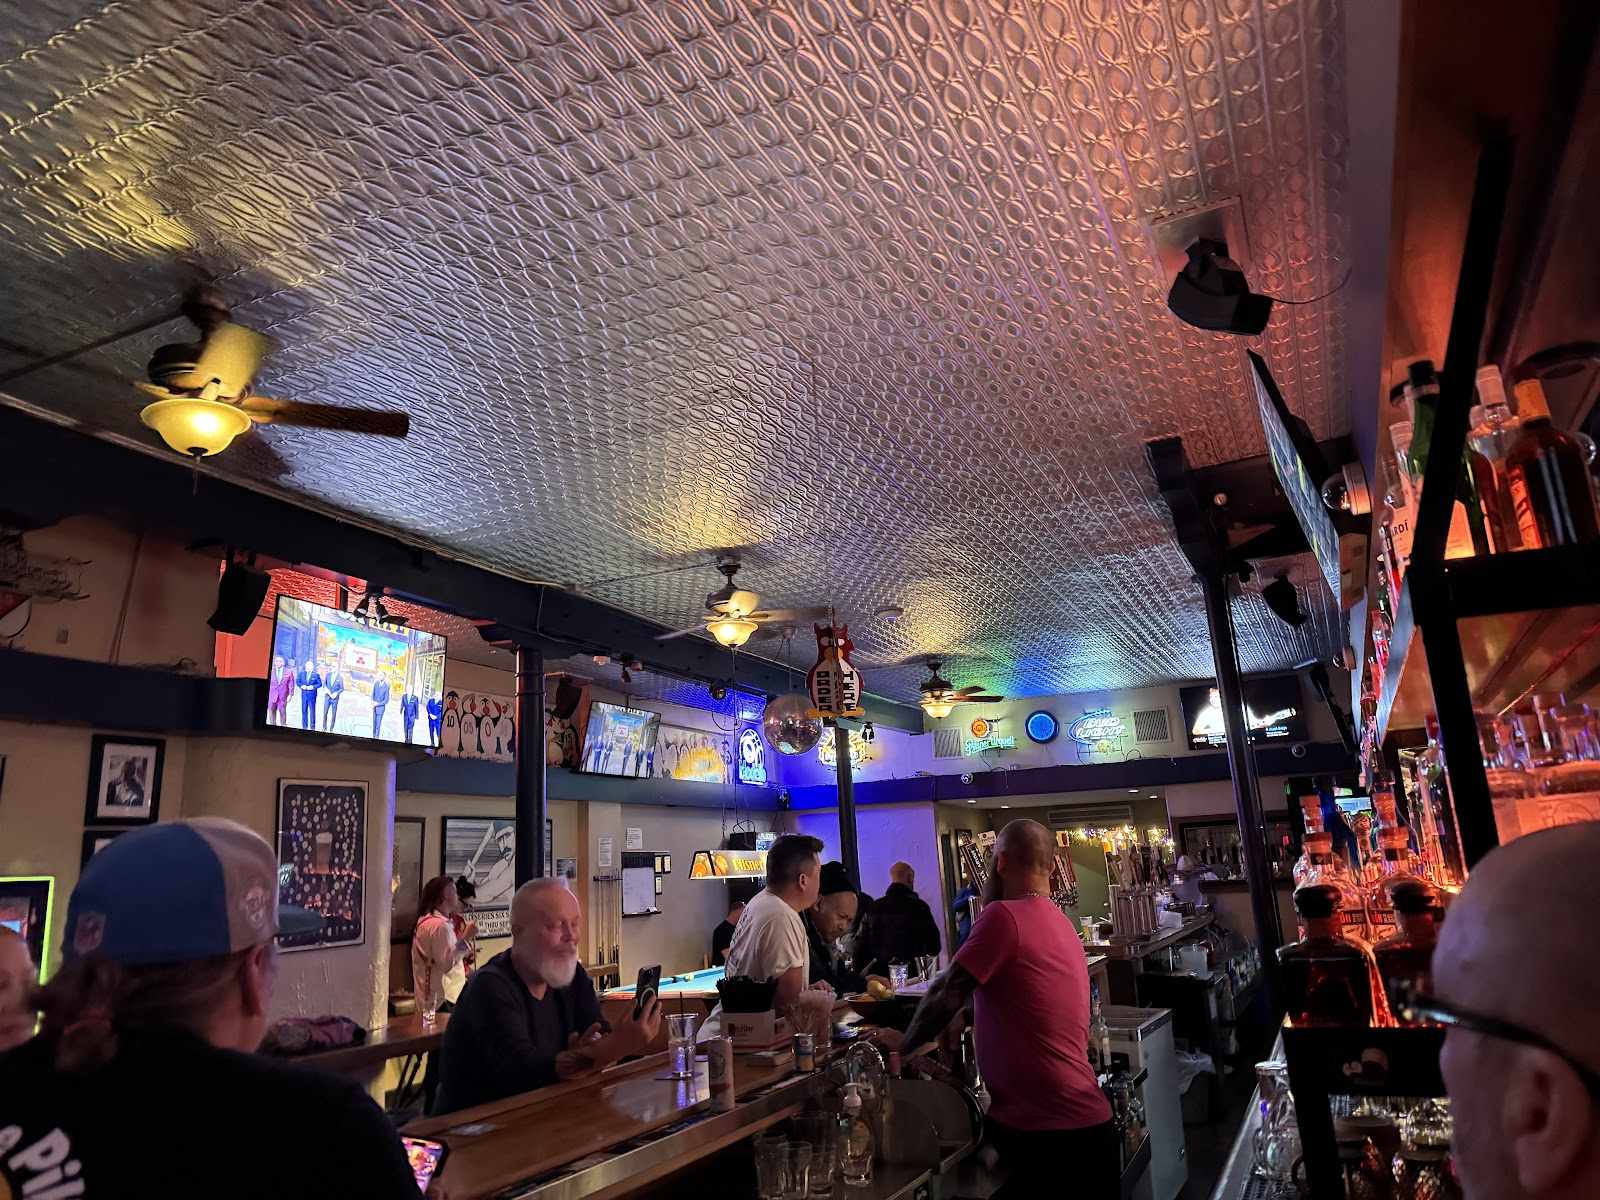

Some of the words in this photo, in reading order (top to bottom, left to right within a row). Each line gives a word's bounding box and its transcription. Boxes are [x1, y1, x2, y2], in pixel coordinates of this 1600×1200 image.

[1391, 518, 1410, 538] ARDÍ
[816, 671, 832, 711] ORDER
[843, 671, 857, 711] HERE
[447, 715, 455, 728] 10
[1083, 717, 1121, 729] BUD
[1076, 725, 1126, 738] LIGHT
[965, 738, 991, 757] Pilsner
[732, 858, 766, 871] Pilsner
[474, 911, 495, 921] SERIES
